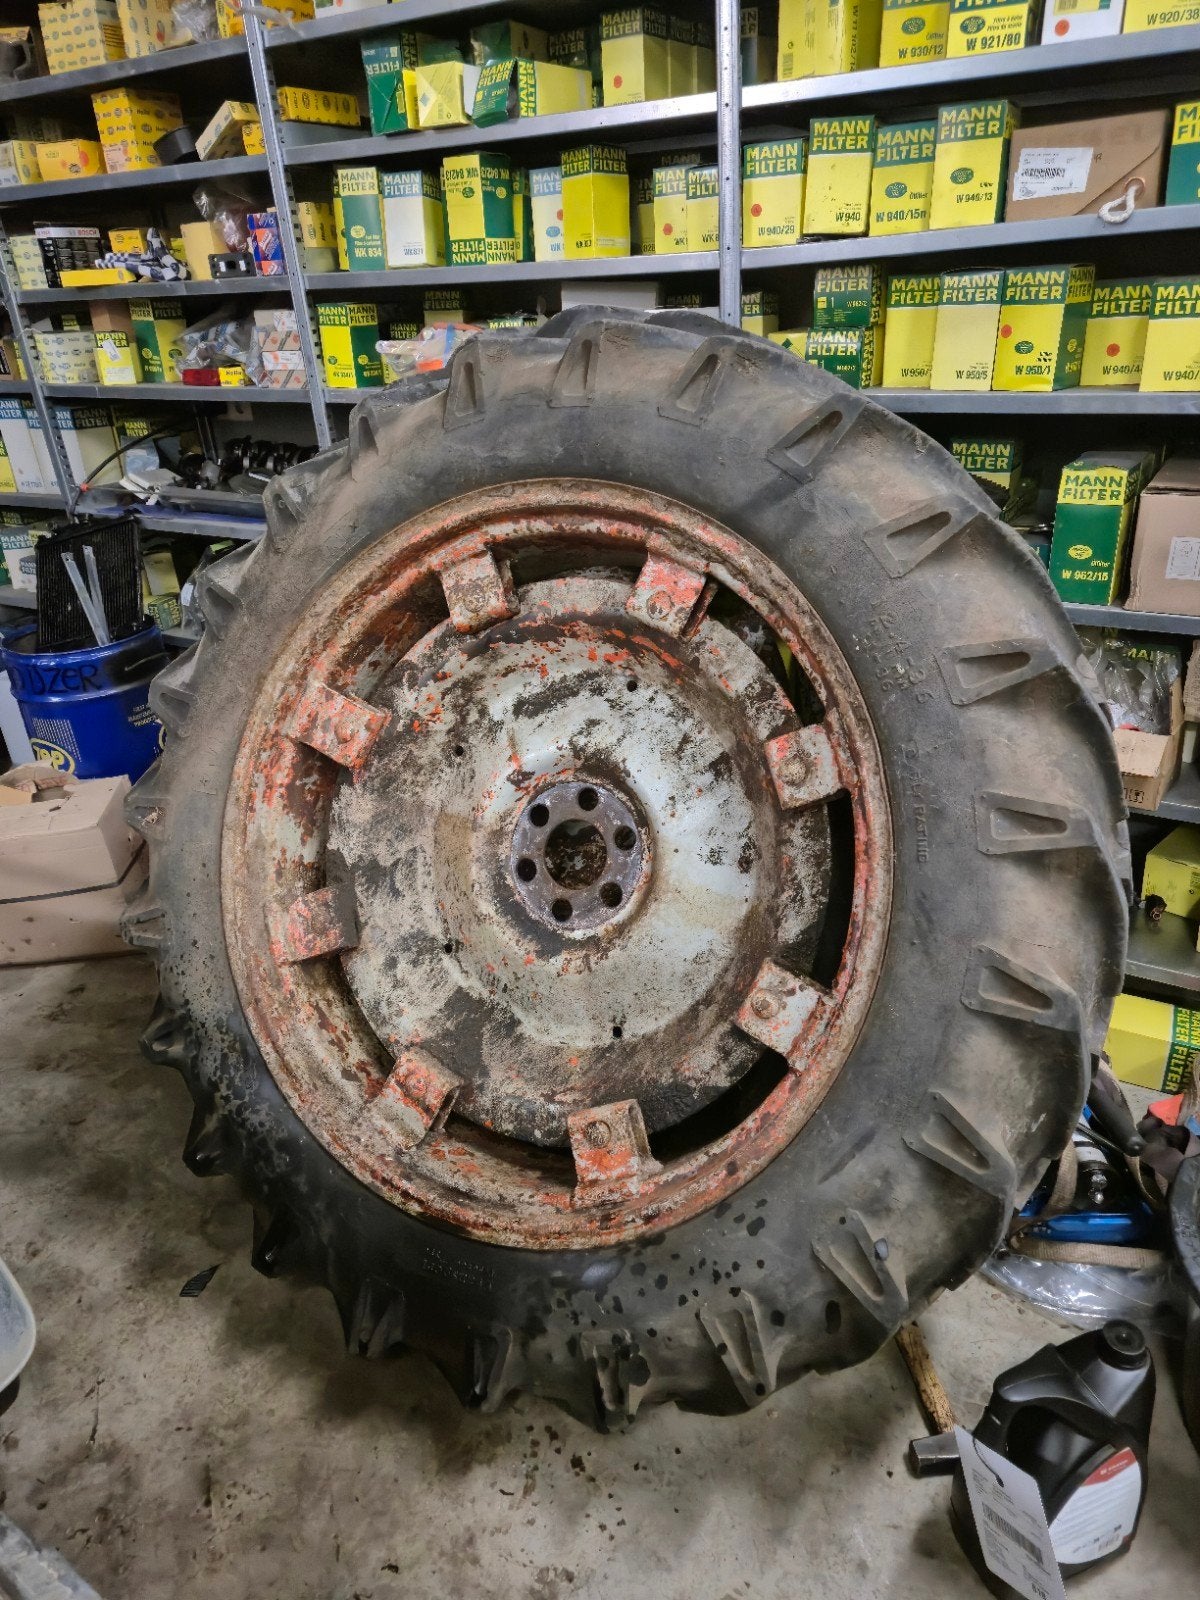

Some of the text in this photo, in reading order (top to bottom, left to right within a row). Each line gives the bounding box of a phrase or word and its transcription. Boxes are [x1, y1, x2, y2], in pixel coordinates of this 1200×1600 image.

[602, 9, 640, 25] MANN
[1147, 8, 1200, 26] W 920/38
[602, 21, 641, 38] FILTER
[967, 33, 1021, 51] W 921/80
[898, 45, 944, 59] W 930/12
[366, 61, 400, 75] FILTER
[480, 60, 513, 79] MANN
[478, 70, 509, 88] FILTER
[519, 61, 528, 117] MANN
[527, 63, 535, 117] FILTER
[941, 104, 1001, 125] MANN
[814, 120, 870, 136] MANN
[940, 120, 1000, 140] FILTER
[812, 136, 868, 151] FILTER
[877, 127, 935, 147] MANN
[562, 148, 591, 163] MANN
[592, 147, 627, 159] MANN
[746, 143, 798, 161] MANN
[876, 143, 934, 163] FILTER
[562, 161, 591, 175] FILTER
[593, 159, 627, 172] FILTER
[746, 158, 797, 175] FILTER
[341, 170, 375, 182] MANN
[383, 172, 420, 185] MANN
[533, 172, 562, 184] MAN
[655, 169, 685, 183] MAN
[688, 169, 719, 184] MAN
[341, 181, 375, 192] FILTER
[384, 184, 420, 195] FILTER
[533, 181, 562, 193] FILTE
[655, 181, 687, 194] FILTE
[688, 182, 719, 196] FILT
[836, 212, 861, 222] W 940
[876, 212, 884, 222] W
[758, 227, 765, 236] W
[452, 241, 485, 252] FILTER
[486, 241, 514, 251] FILTER
[452, 252, 485, 263] MANN
[487, 252, 515, 262] MANN
[818, 265, 870, 279] MANN
[1007, 270, 1066, 285] MANN
[817, 278, 869, 293] FILTER
[943, 273, 1000, 288] MANN
[942, 288, 998, 302] FILTER
[1005, 286, 1063, 301] FILTER
[1156, 284, 1200, 300] MAN
[318, 306, 346, 316] MANN
[349, 305, 376, 314] MANN
[1154, 300, 1200, 315] FILT
[319, 315, 349, 325] FILTER
[350, 314, 377, 324] FILTER
[96, 332, 126, 340] MANN
[810, 331, 859, 343] MANN
[97, 339, 128, 347] FER
[808, 343, 858, 356] FILTER
[901, 368, 908, 377] W
[956, 370, 964, 380] W
[1015, 365, 1024, 375] W
[1103, 364, 1143, 375] W 940/4
[1163, 370, 1200, 380] W 940/
[952, 443, 1011, 456] MANN
[1065, 475, 1123, 488] MANN
[1063, 488, 1121, 500] FILTER
[1062, 569, 1109, 581] W 962/15
[1166, 1045, 1188, 1091] FILTER
